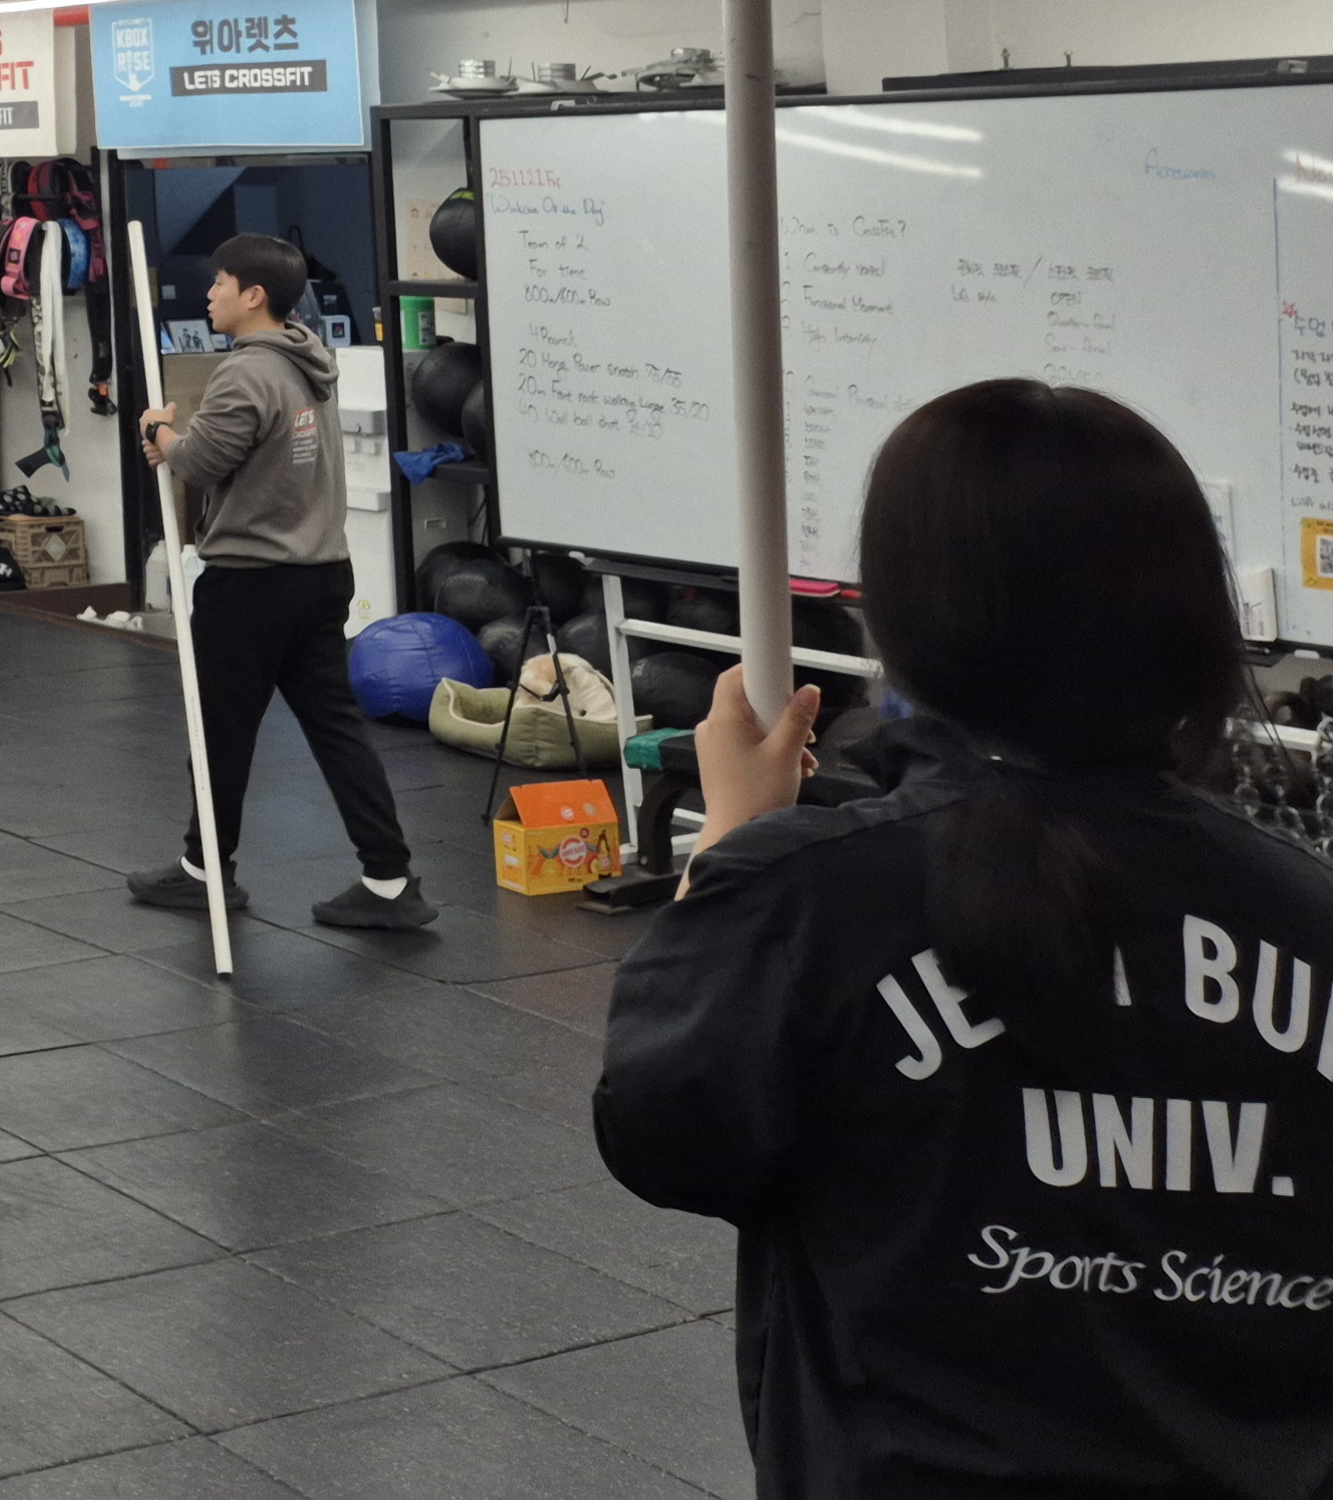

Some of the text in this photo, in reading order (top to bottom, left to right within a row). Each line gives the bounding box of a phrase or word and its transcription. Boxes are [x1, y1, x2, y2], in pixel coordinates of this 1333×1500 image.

[191, 15, 300, 56] 위아렛츠
[183, 66, 313, 90] LETS CROSSFIT
[518, 230, 549, 250] Team
[528, 258, 548, 278] For
[1022, 1088, 1295, 1197] UNIV.
[967, 1225, 1333, 1312] Sports Science
